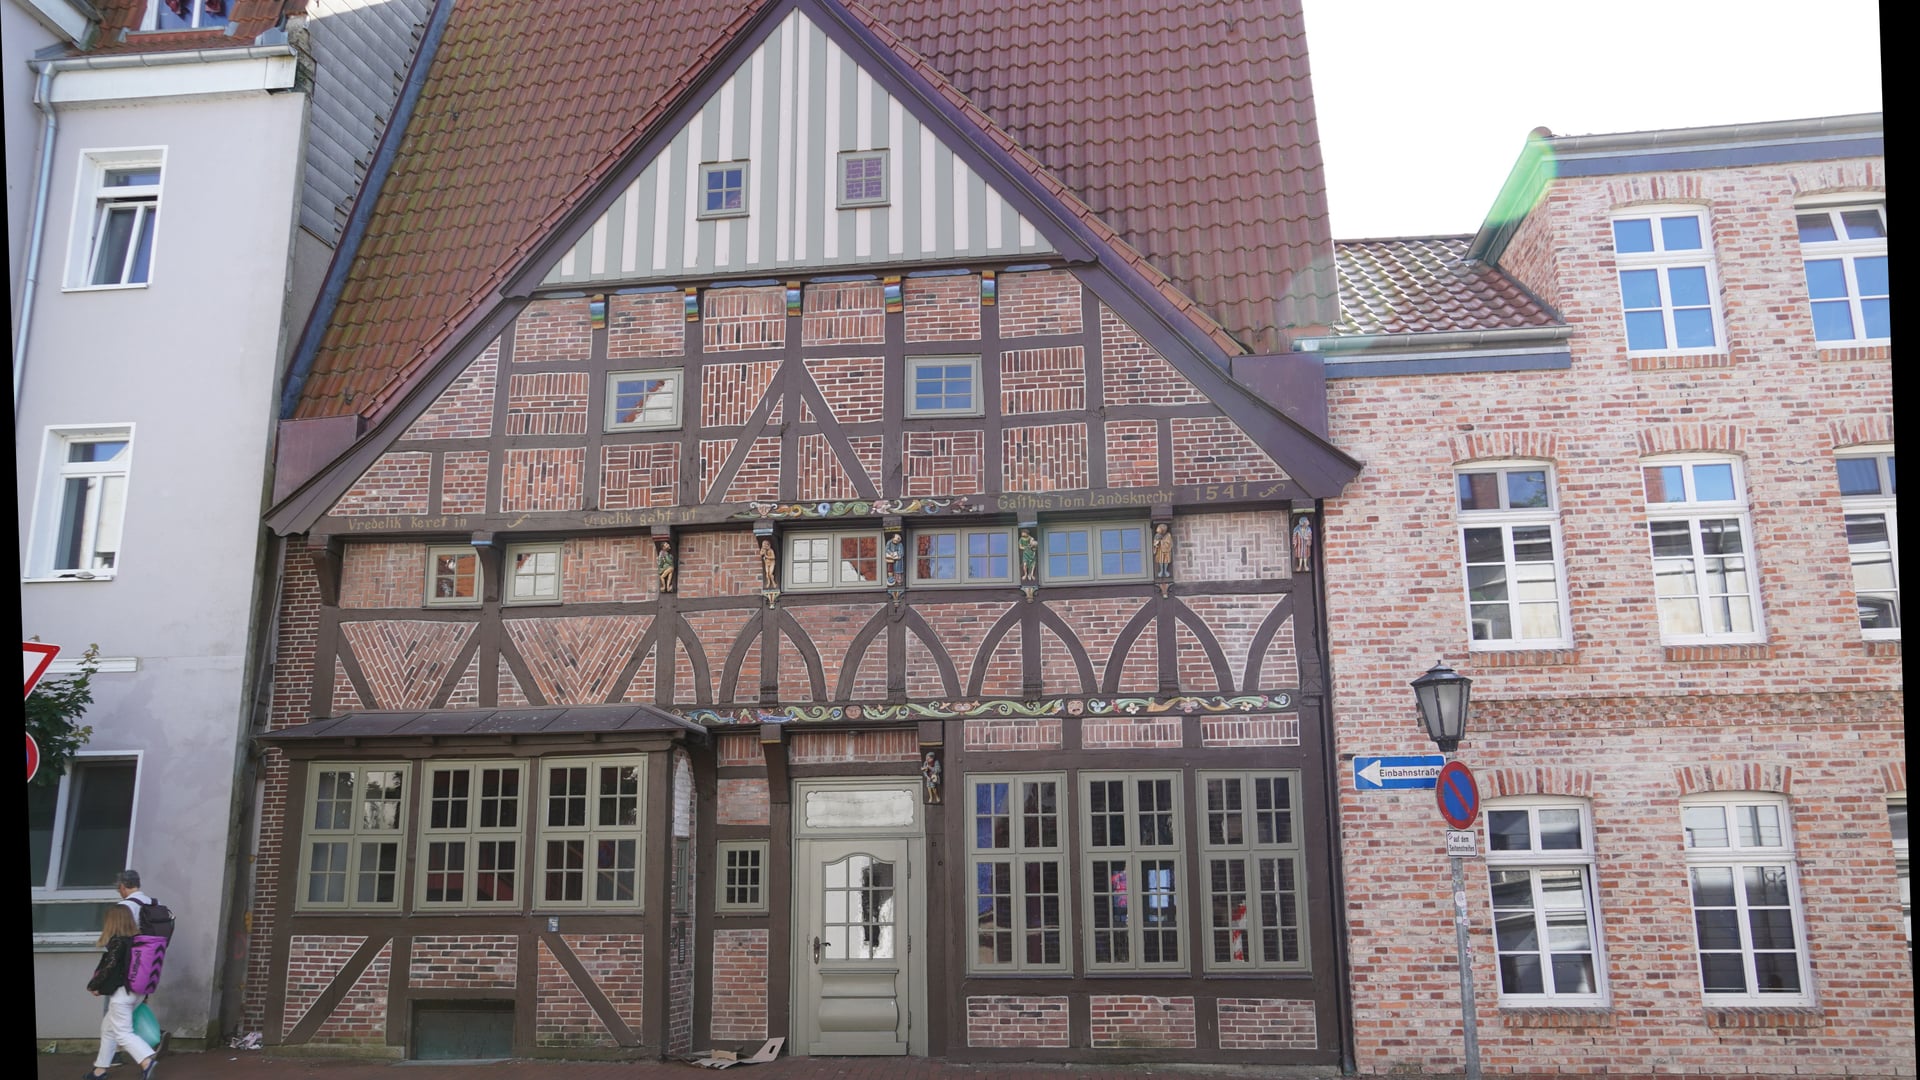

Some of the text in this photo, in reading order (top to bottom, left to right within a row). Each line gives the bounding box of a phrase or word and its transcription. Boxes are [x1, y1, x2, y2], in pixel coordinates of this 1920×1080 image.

[1089, 490, 1175, 507] Landsknecht
[1194, 483, 1249, 501] 1541
[454, 517, 467, 528] in
[1380, 768, 1440, 778] Einbahnstraße
